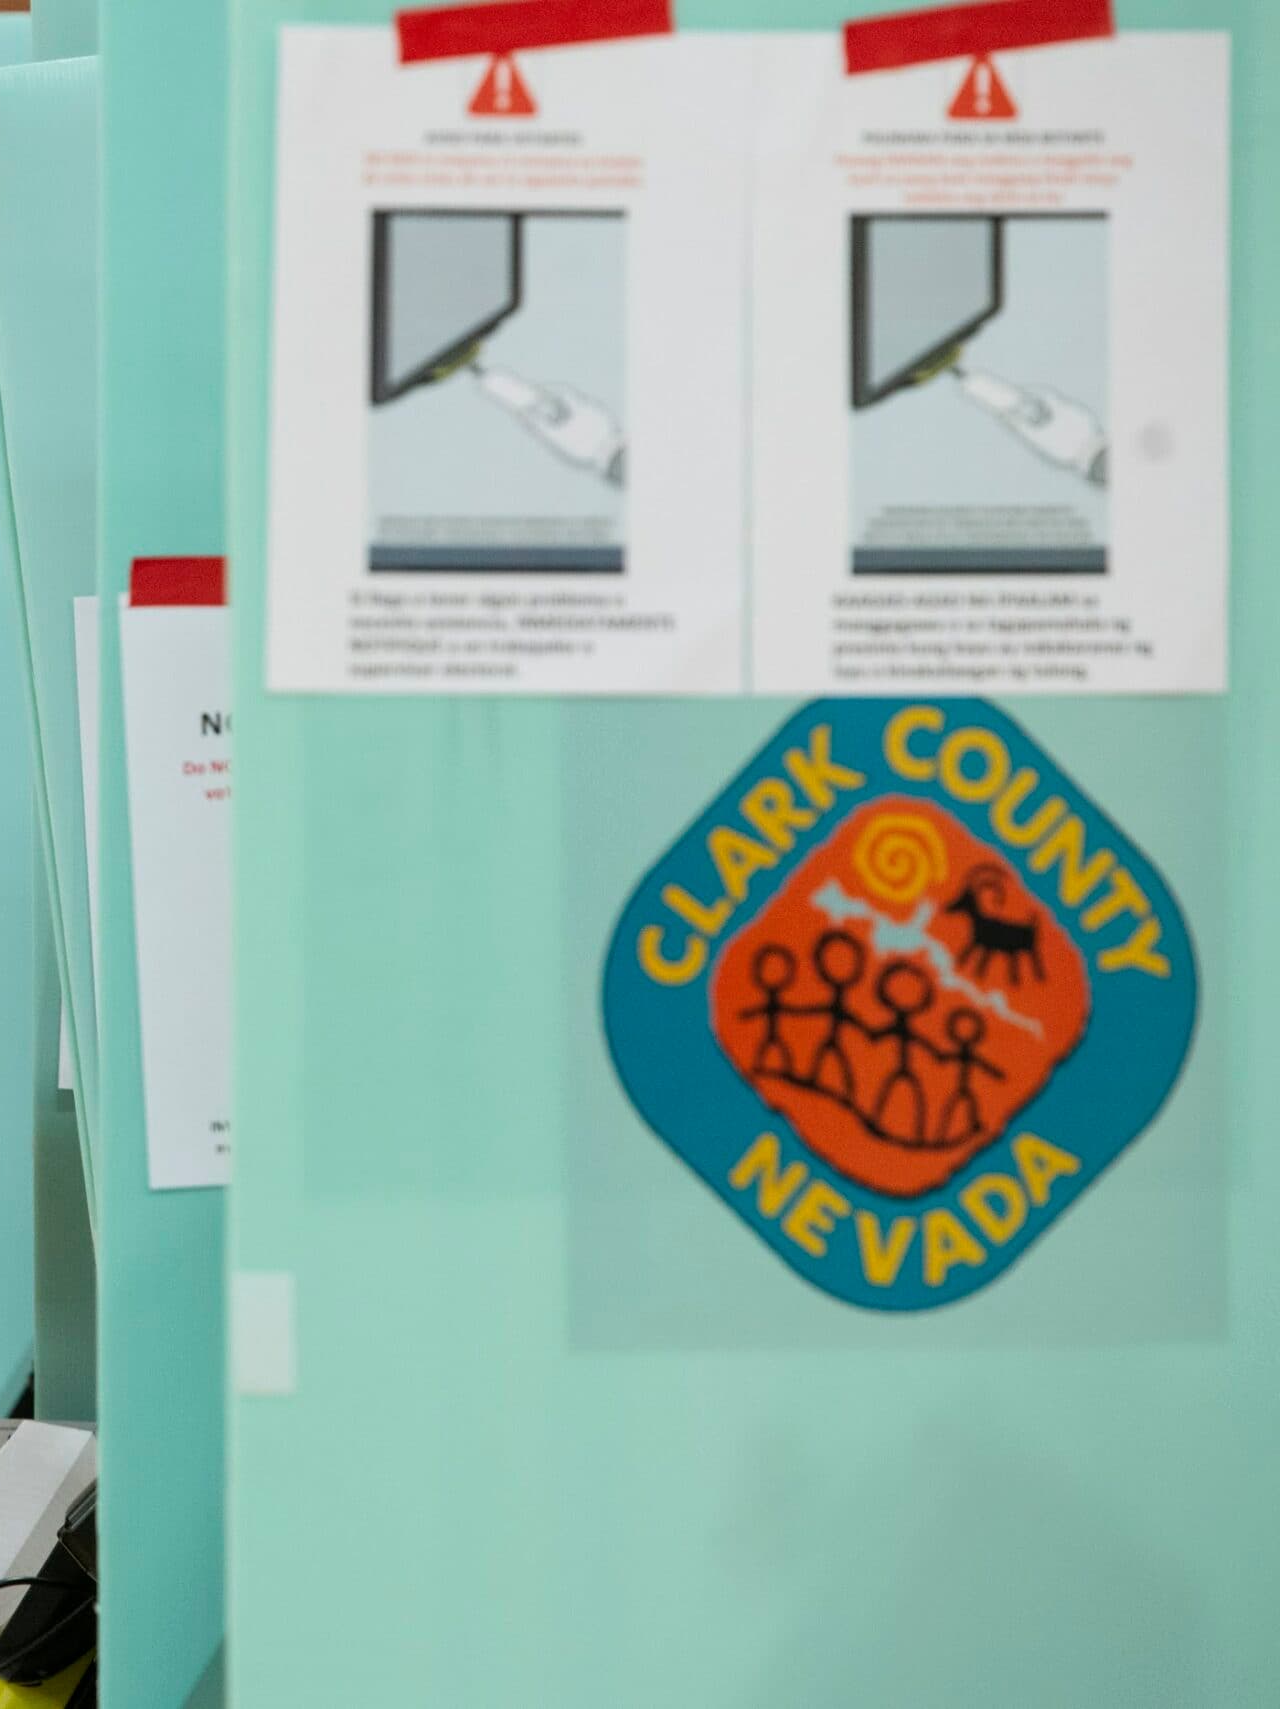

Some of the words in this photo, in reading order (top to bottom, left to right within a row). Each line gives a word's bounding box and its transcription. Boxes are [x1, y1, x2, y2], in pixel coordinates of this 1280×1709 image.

[637, 724, 866, 986] CLARK
[883, 706, 1172, 978] COUNTY
[728, 1132, 1080, 1287] NEVADA
